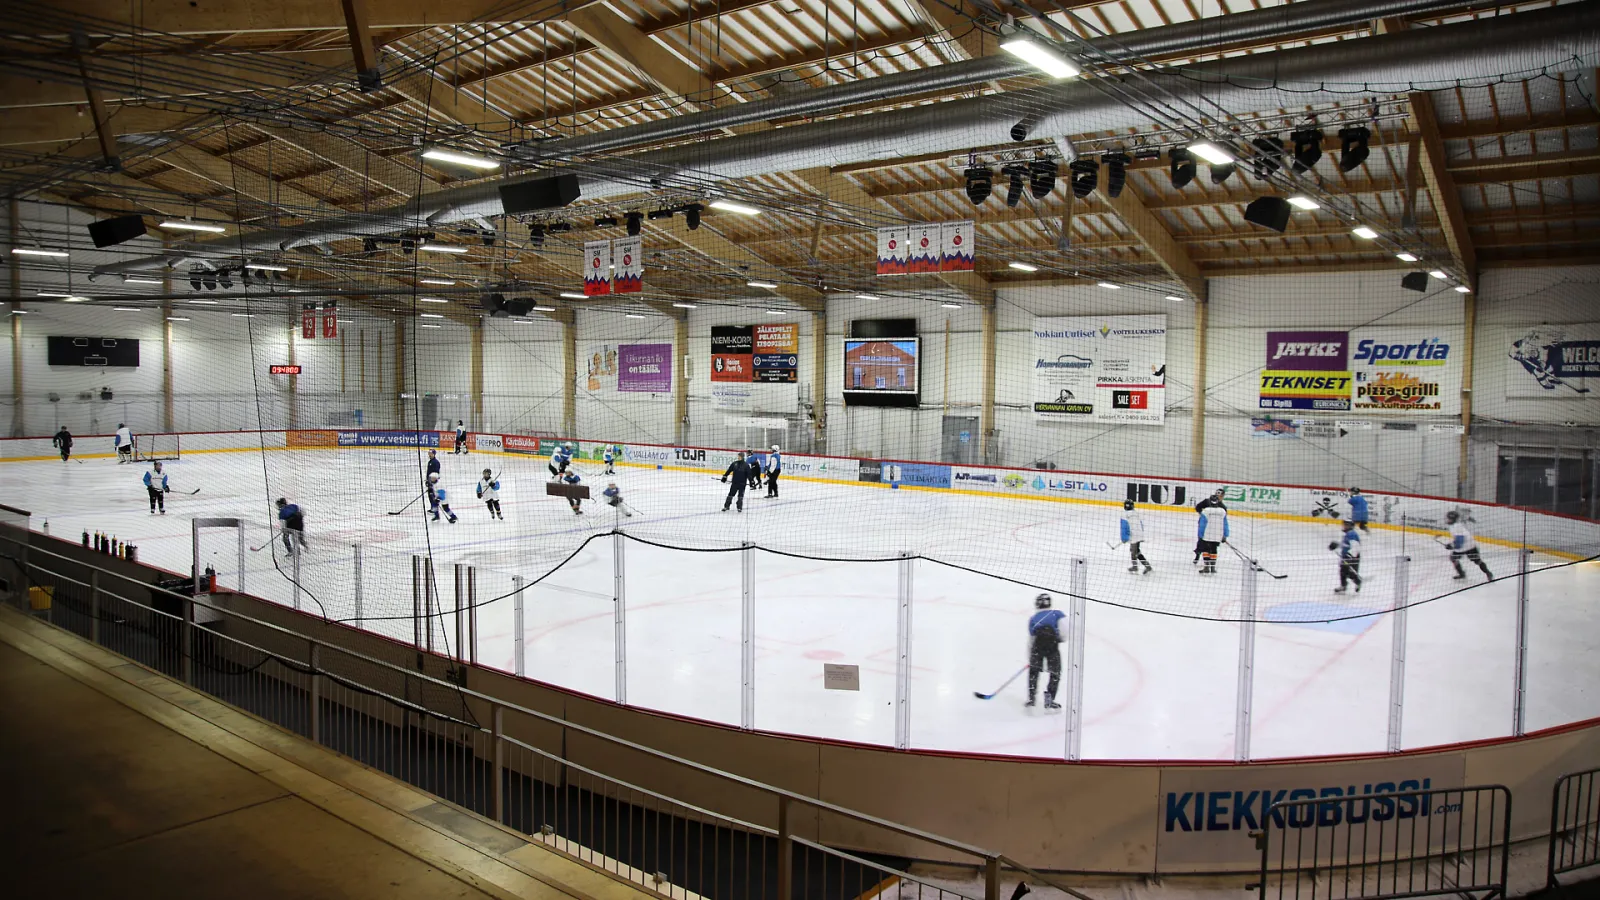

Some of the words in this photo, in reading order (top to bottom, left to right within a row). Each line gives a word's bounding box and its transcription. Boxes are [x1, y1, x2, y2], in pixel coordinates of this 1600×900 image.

[1034, 330, 1065, 339] Nokian
[1065, 329, 1096, 338] Uutiset
[1273, 342, 1342, 359] JATKE
[1353, 338, 1450, 365] Sportia
[1261, 376, 1351, 390] TEKNISET
[1357, 383, 1439, 398] pizza-grilli
[1354, 401, 1441, 411] www.kultapizza.fi
[674, 448, 706, 462] TOJA
[1250, 487, 1282, 500] TPM
